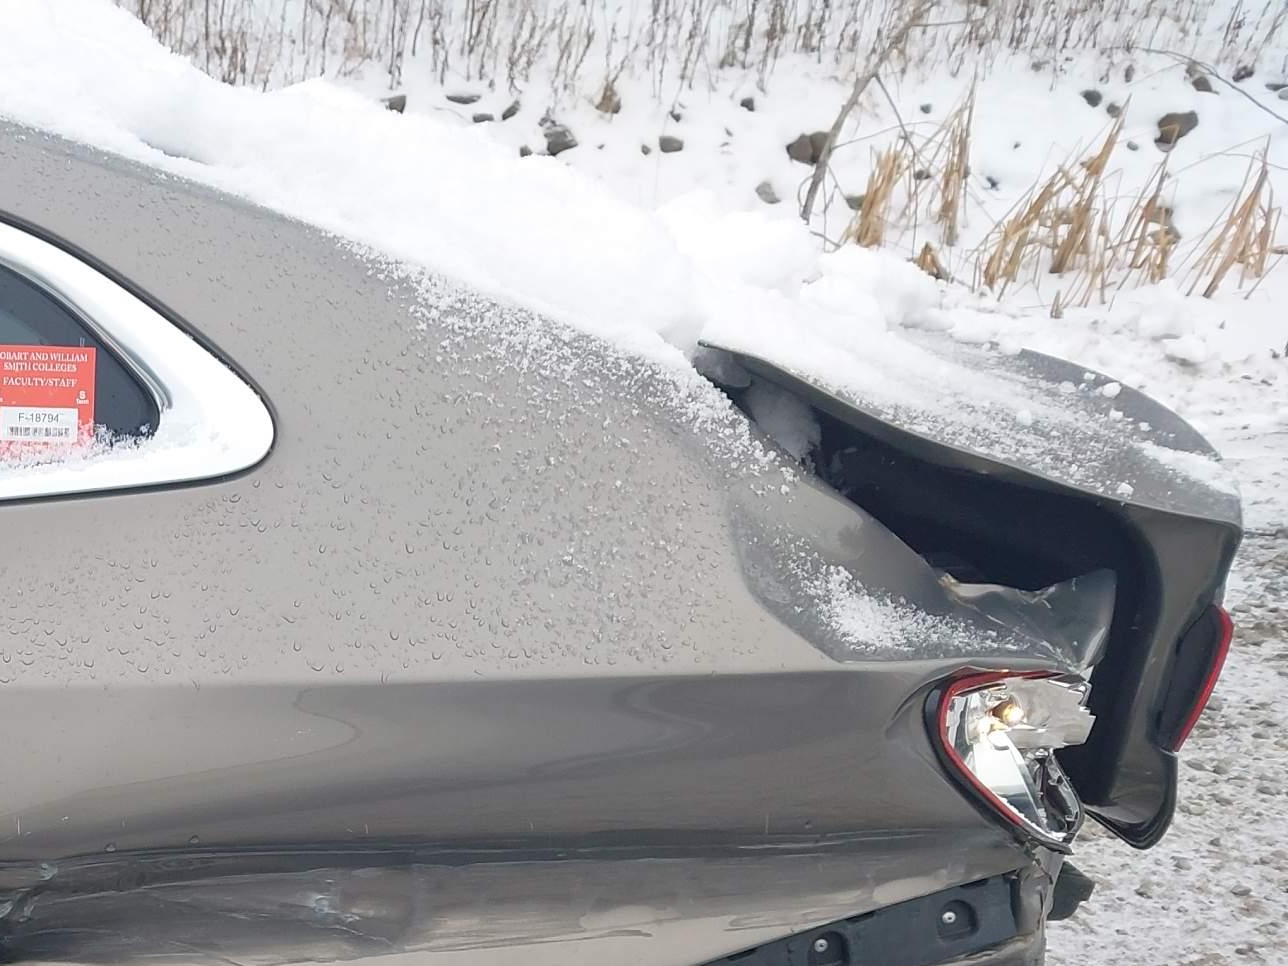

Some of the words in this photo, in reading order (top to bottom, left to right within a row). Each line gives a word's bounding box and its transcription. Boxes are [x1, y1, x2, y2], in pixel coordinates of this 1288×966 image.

[30, 352, 49, 362] AND
[50, 353, 88, 362] WILLIAM
[3, 362, 31, 372] SMITH
[32, 363, 77, 373] COLLEGES
[3, 376, 77, 388] FACULTY/STAFF
[18, 412, 59, 423] F-18794
